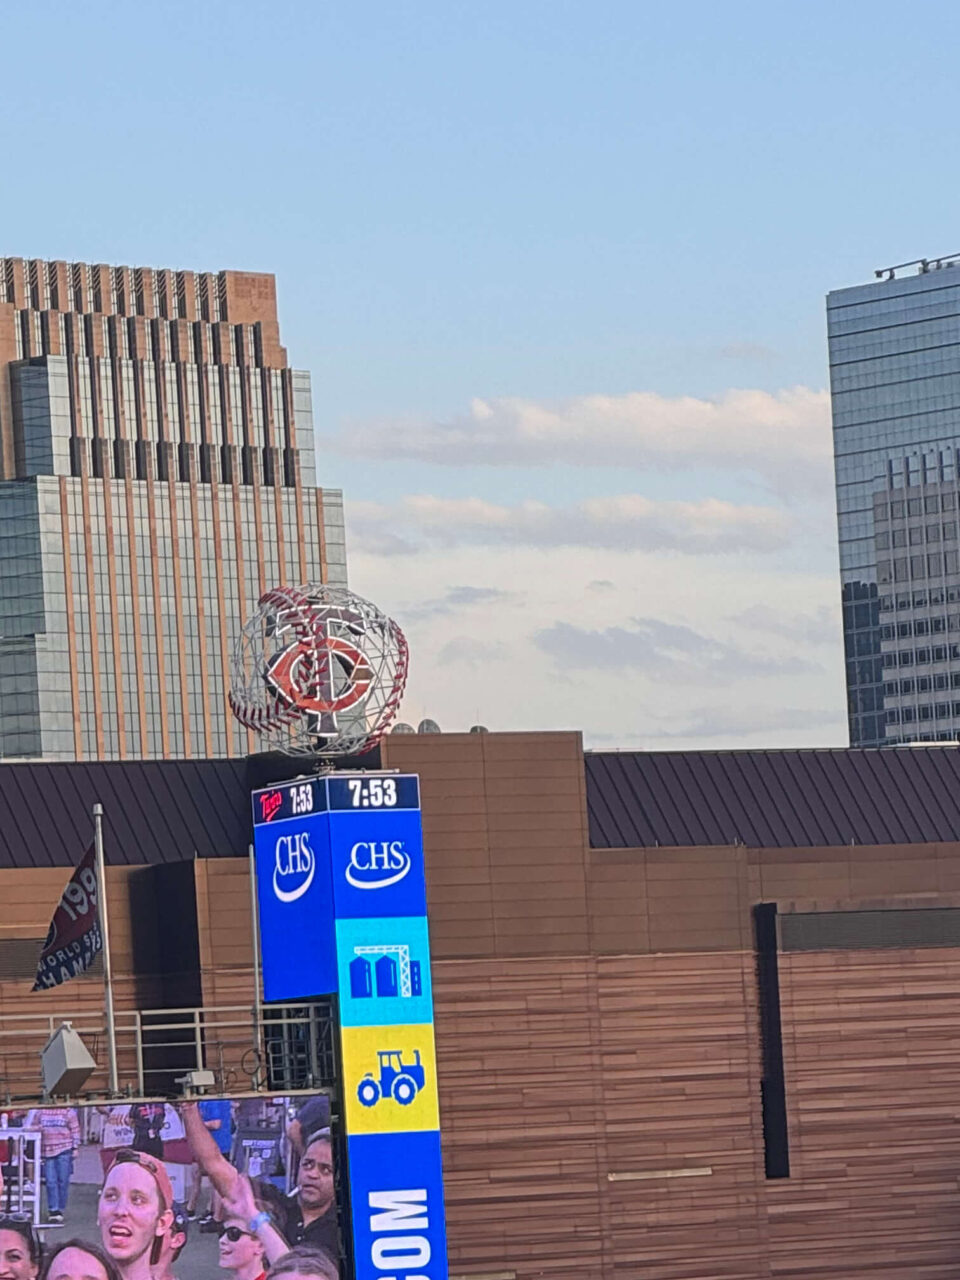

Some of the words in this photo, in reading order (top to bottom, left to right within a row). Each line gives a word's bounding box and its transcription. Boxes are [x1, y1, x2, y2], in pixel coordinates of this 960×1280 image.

[290, 783, 314, 814] 7:53
[348, 779, 398, 808] 7:53
[275, 832, 312, 876] CHS
[350, 841, 405, 871] CHS
